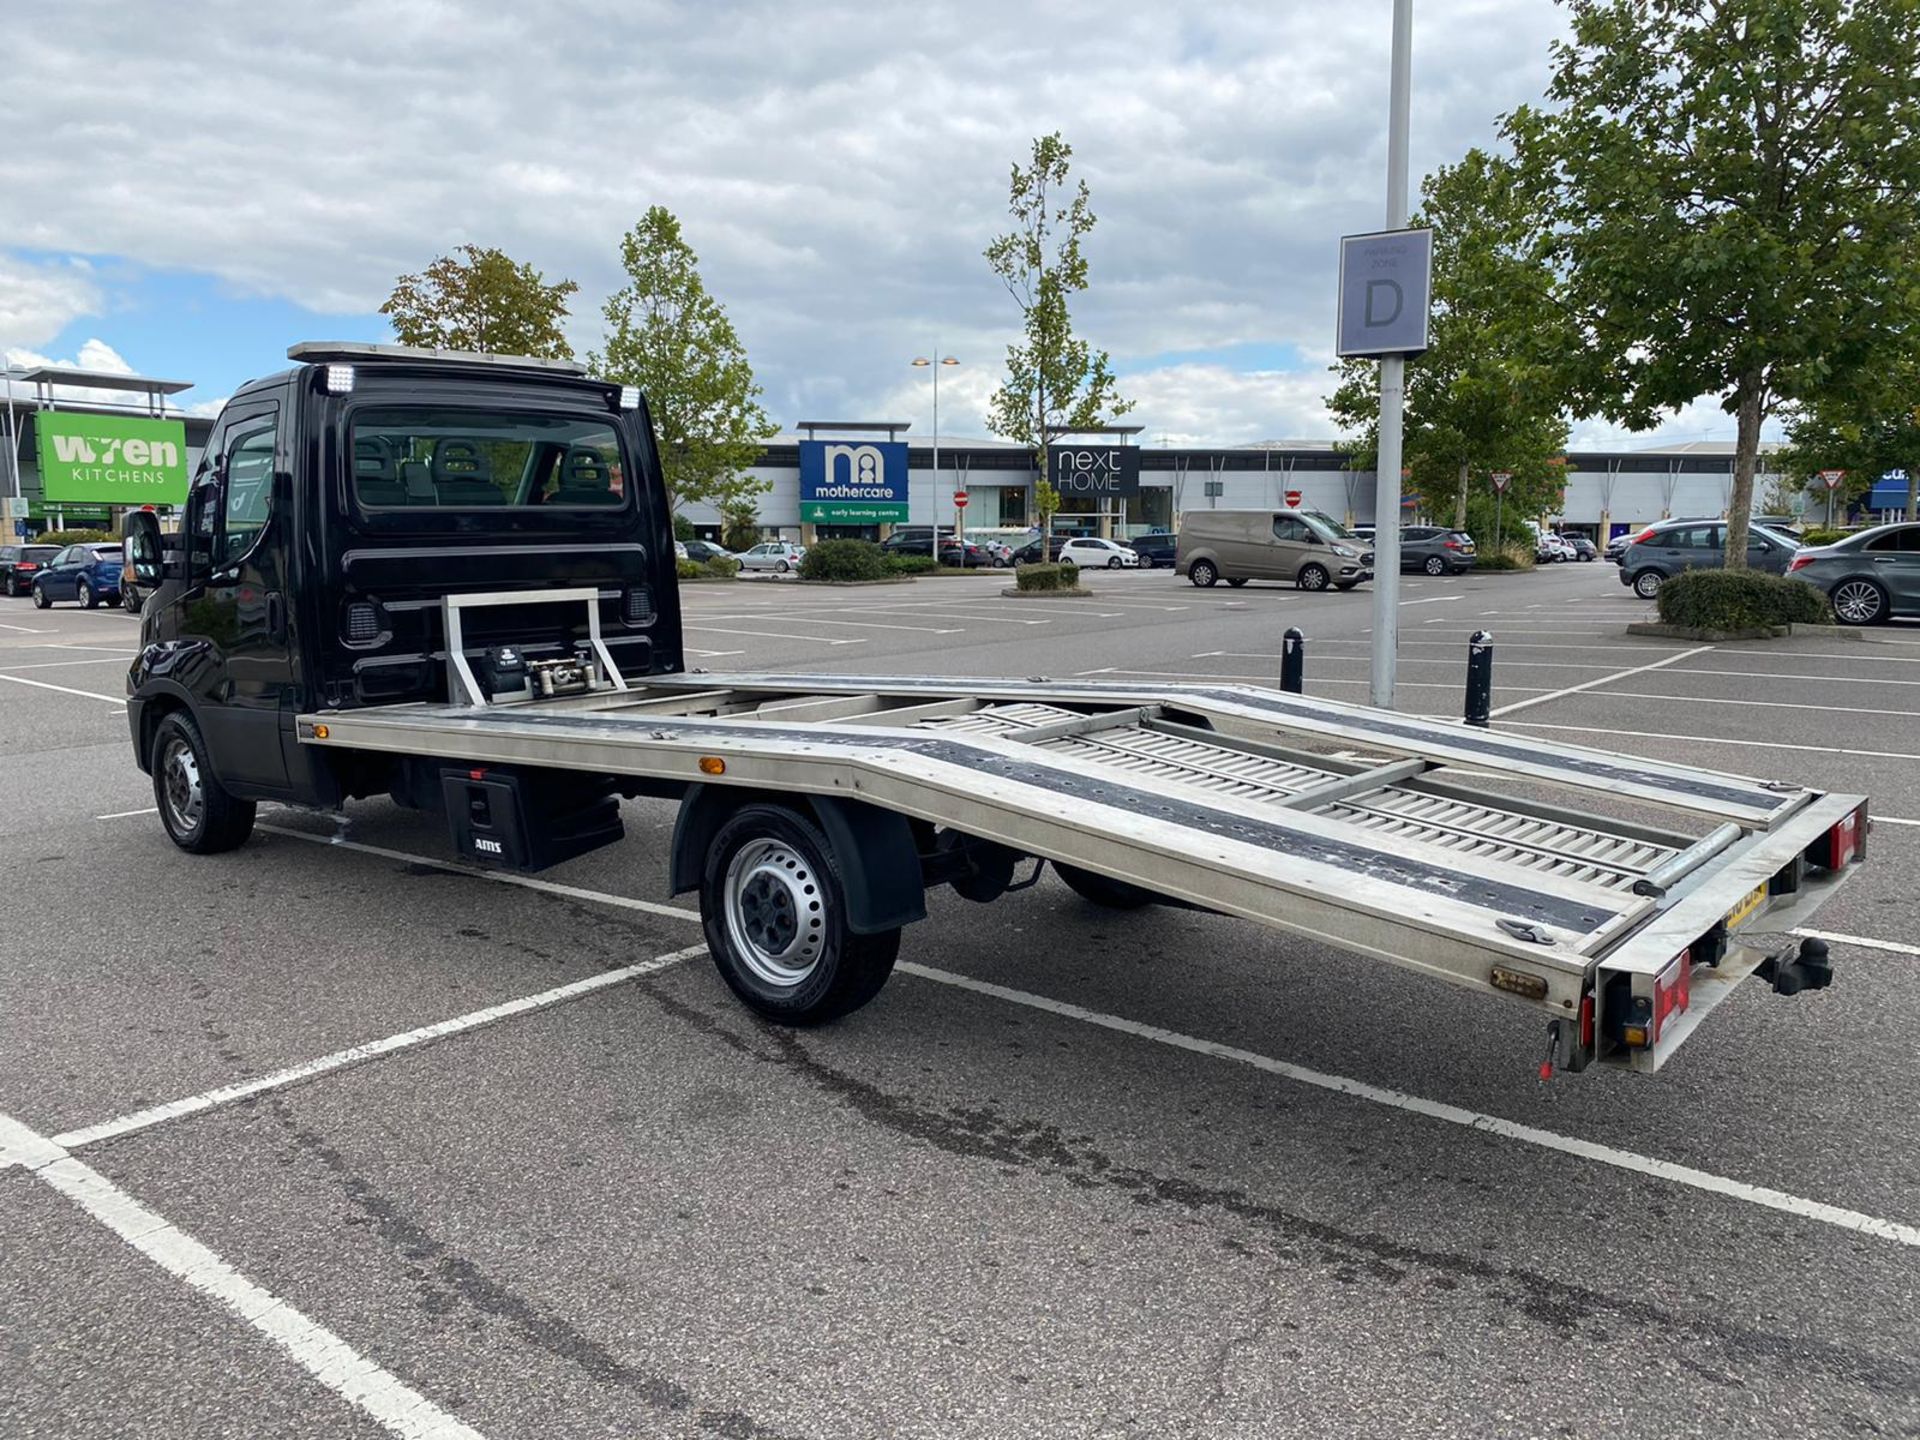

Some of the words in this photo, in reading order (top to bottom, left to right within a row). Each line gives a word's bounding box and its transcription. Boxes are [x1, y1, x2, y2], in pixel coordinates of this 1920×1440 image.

[1365, 279, 1404, 328] D
[52, 434, 178, 467] wren
[1058, 450, 1121, 470] next
[72, 468, 164, 484] KITCHENS
[1058, 471, 1121, 491] HOME
[815, 484, 894, 498] mothercare
[831, 509, 848, 517] early
[849, 509, 877, 517] learning
[878, 509, 900, 517] centre
